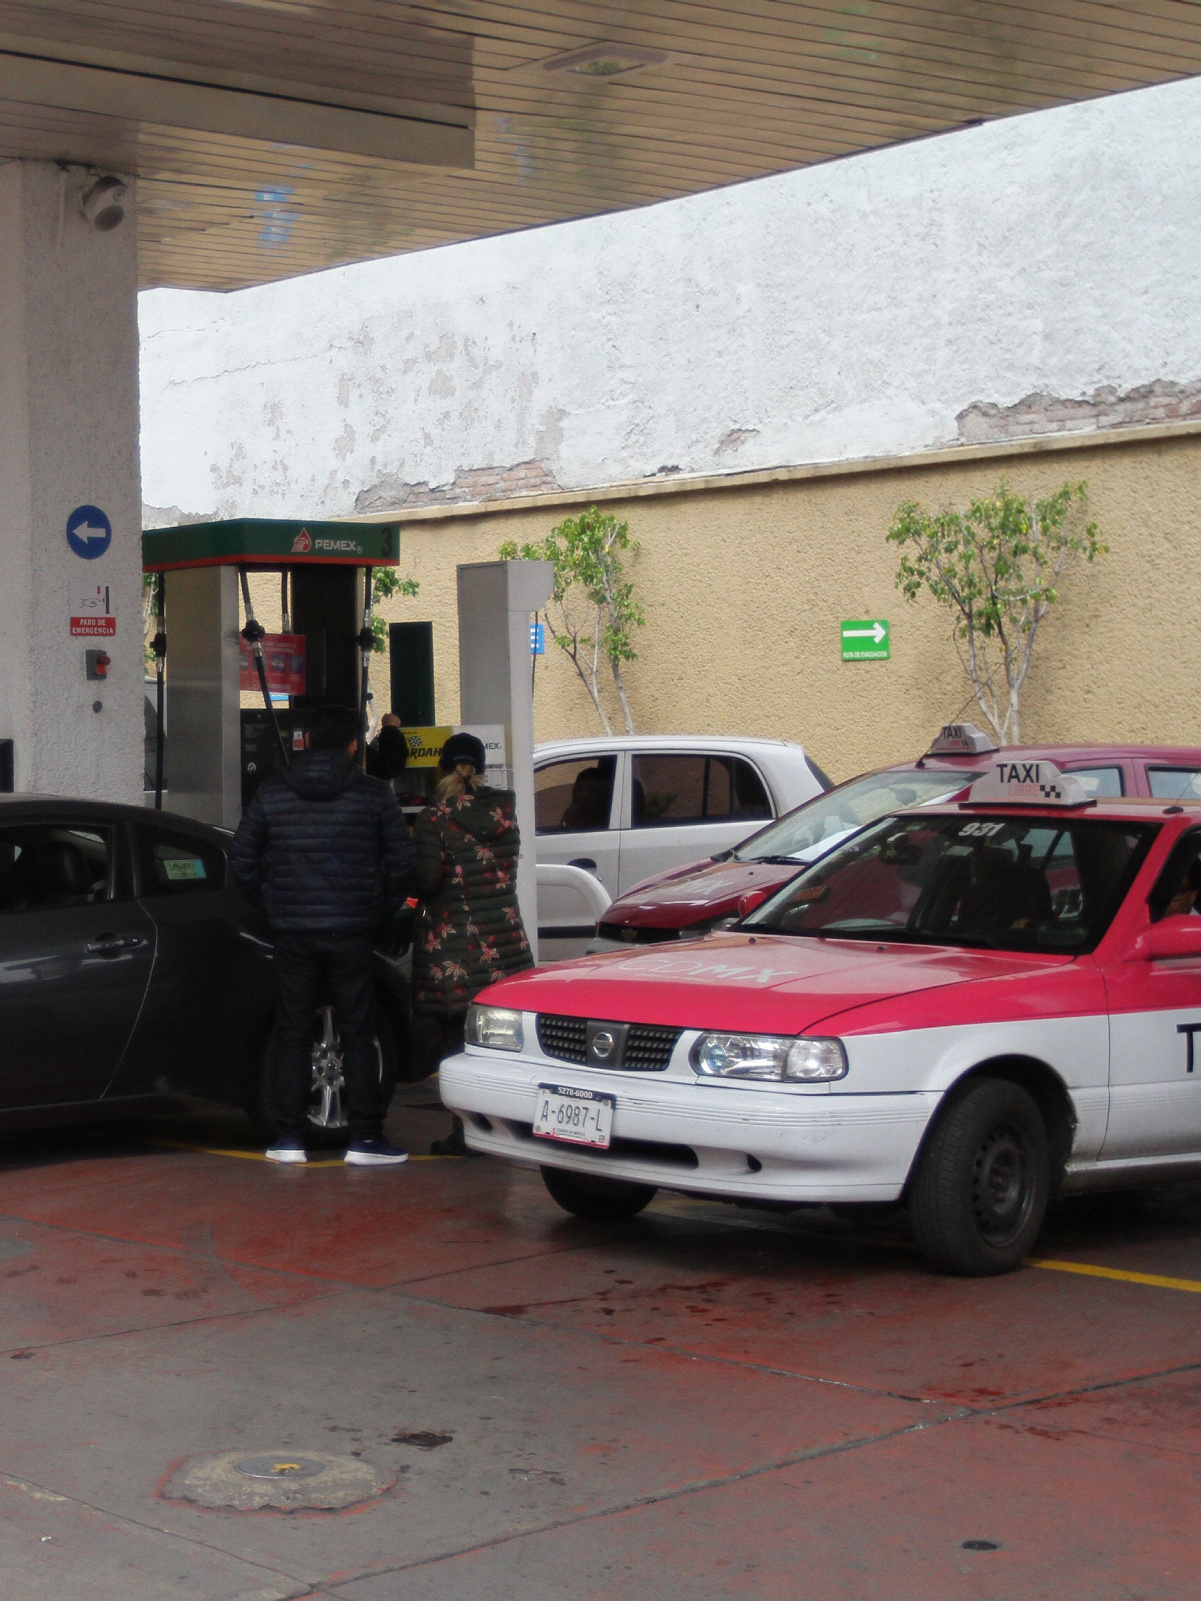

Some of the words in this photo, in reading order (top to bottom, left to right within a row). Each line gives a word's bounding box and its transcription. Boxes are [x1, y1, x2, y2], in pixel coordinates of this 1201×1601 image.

[315, 540, 356, 550] PEMEX
[381, 527, 392, 557] 3
[942, 726, 962, 739] TAXI
[996, 763, 1040, 784] TAXI
[1008, 784, 1039, 797] LIBRE
[958, 822, 1005, 837] 931
[618, 960, 798, 983] CDMX
[557, 1086, 593, 1099] 5278-6000
[540, 1099, 602, 1132] A-6987-L
